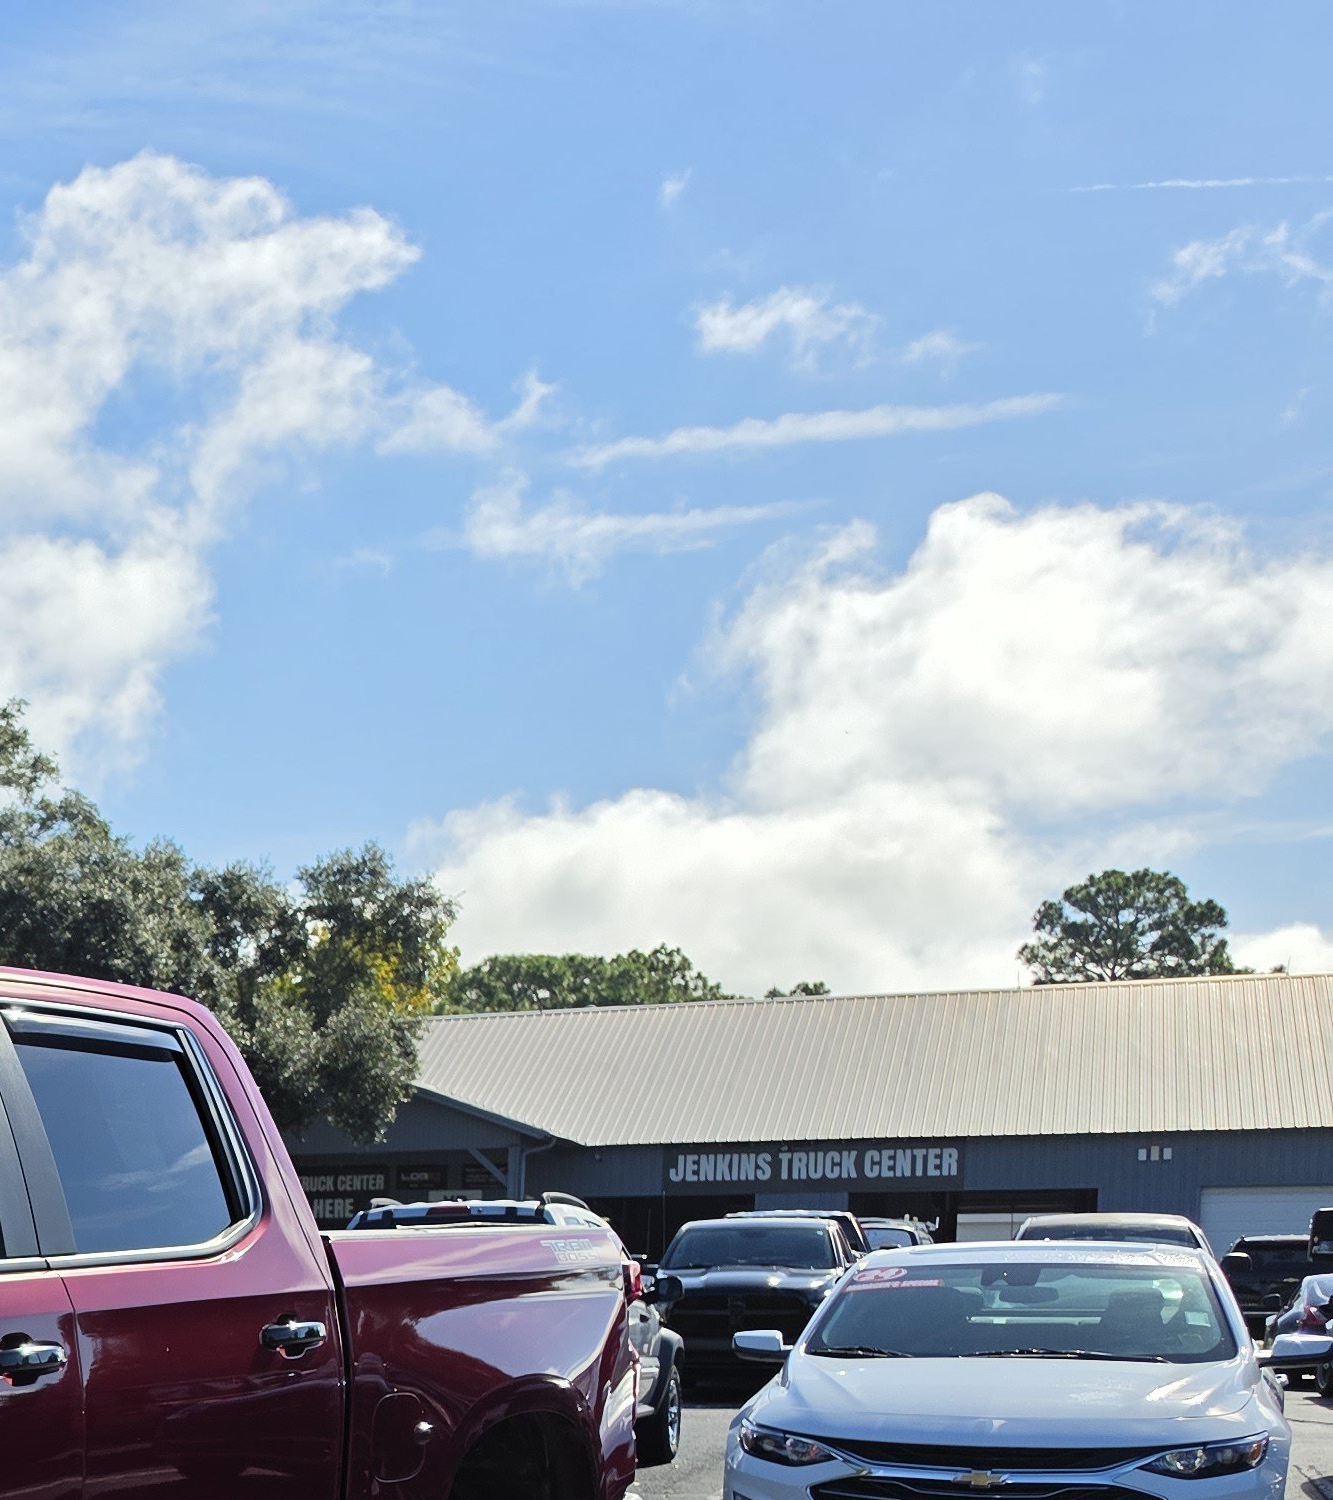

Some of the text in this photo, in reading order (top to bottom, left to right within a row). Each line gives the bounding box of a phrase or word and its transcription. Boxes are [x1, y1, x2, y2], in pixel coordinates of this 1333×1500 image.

[669, 1147, 959, 1182] JENKINS TRUCK CENTER
[337, 1174, 385, 1192] CENTER
[313, 1198, 354, 1219] HERE
[556, 1251, 599, 1264] BOSS
